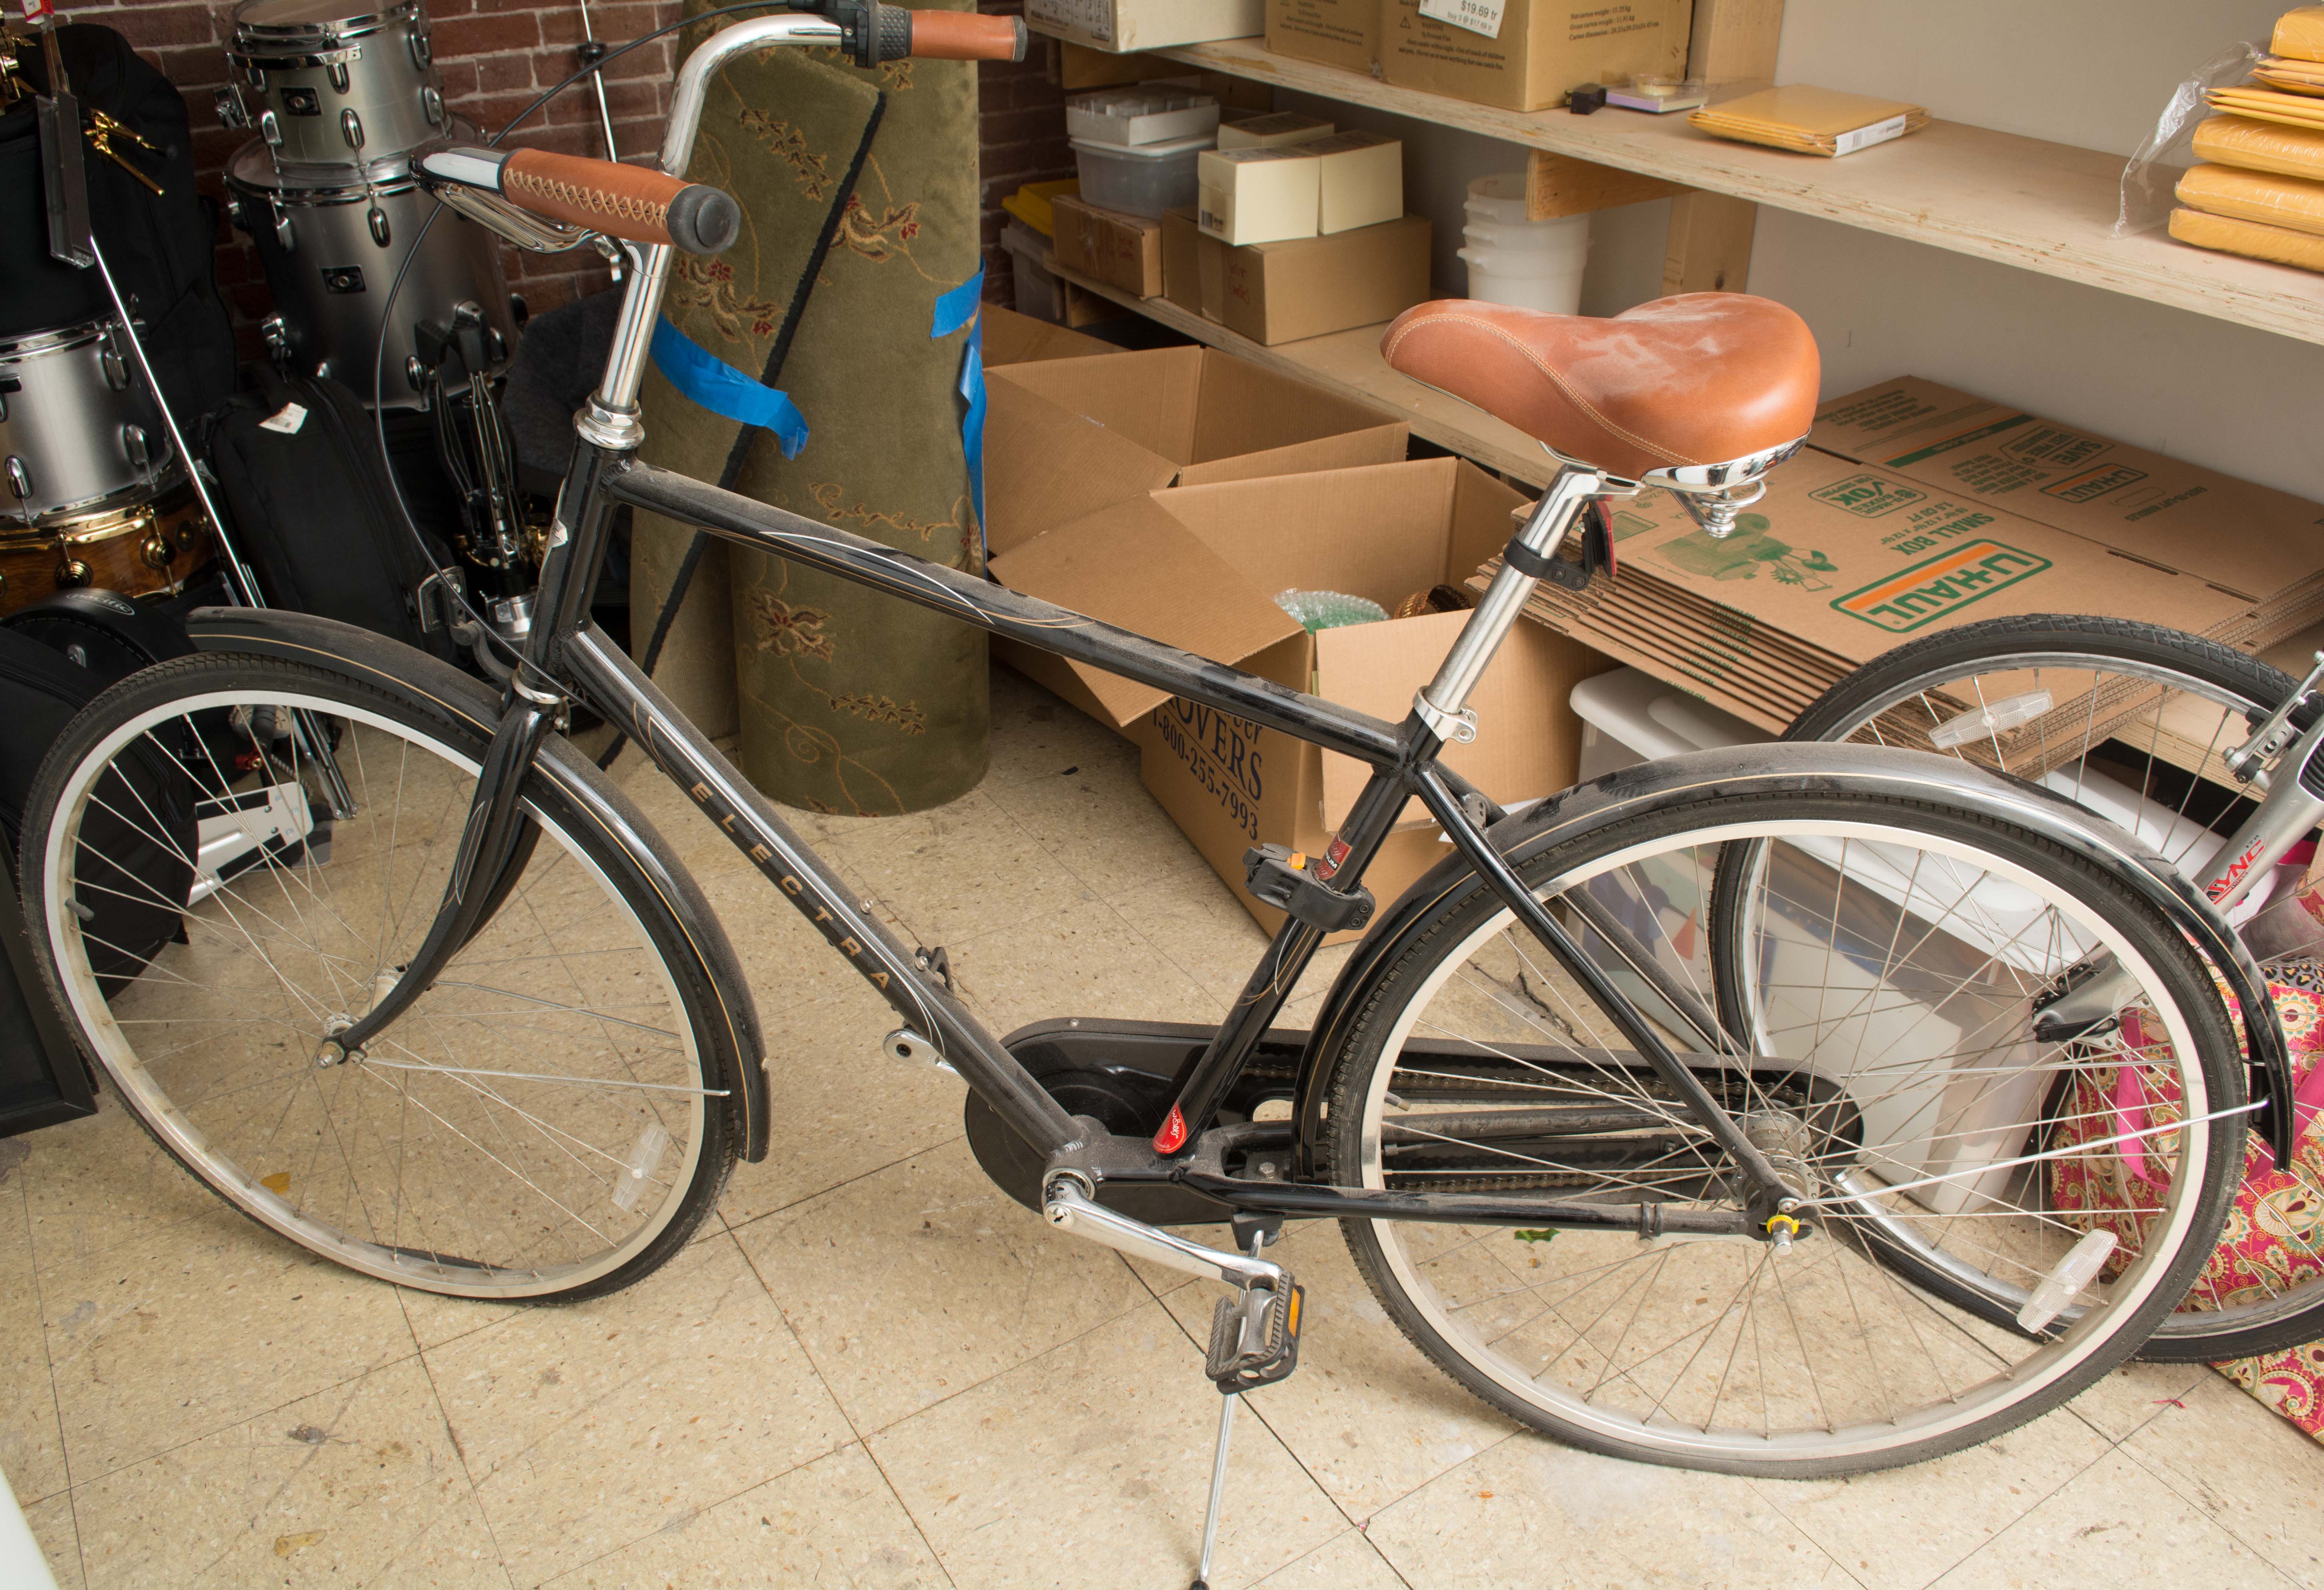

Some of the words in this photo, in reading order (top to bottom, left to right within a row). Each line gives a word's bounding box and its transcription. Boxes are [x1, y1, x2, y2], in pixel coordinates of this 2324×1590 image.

[1448, 12, 1457, 20] buy
[1461, 0, 1489, 18] $19.69
[1491, 8, 1498, 20] tr
[2046, 440, 2107, 466] SAVE!
[2057, 468, 2139, 501] U-HAUL
[1827, 486, 1881, 506] OK
[1848, 493, 1897, 512] BOXES
[1858, 496, 1906, 515] U-HAUL
[1931, 501, 1957, 510] 1.5
[1902, 513, 1927, 522] FT
[1916, 507, 1941, 517] CU
[1926, 512, 1998, 540] SMALL
[1888, 535, 1941, 556] BOX
[1864, 551, 2035, 625] U-HAUL
[1168, 696, 1262, 801] OVERS
[1154, 708, 1258, 841] 1-800-255-7993
[1325, 851, 1338, 869] NUM
[2206, 839, 2265, 901] SYNC
[691, 781, 891, 989] ELECTRA
